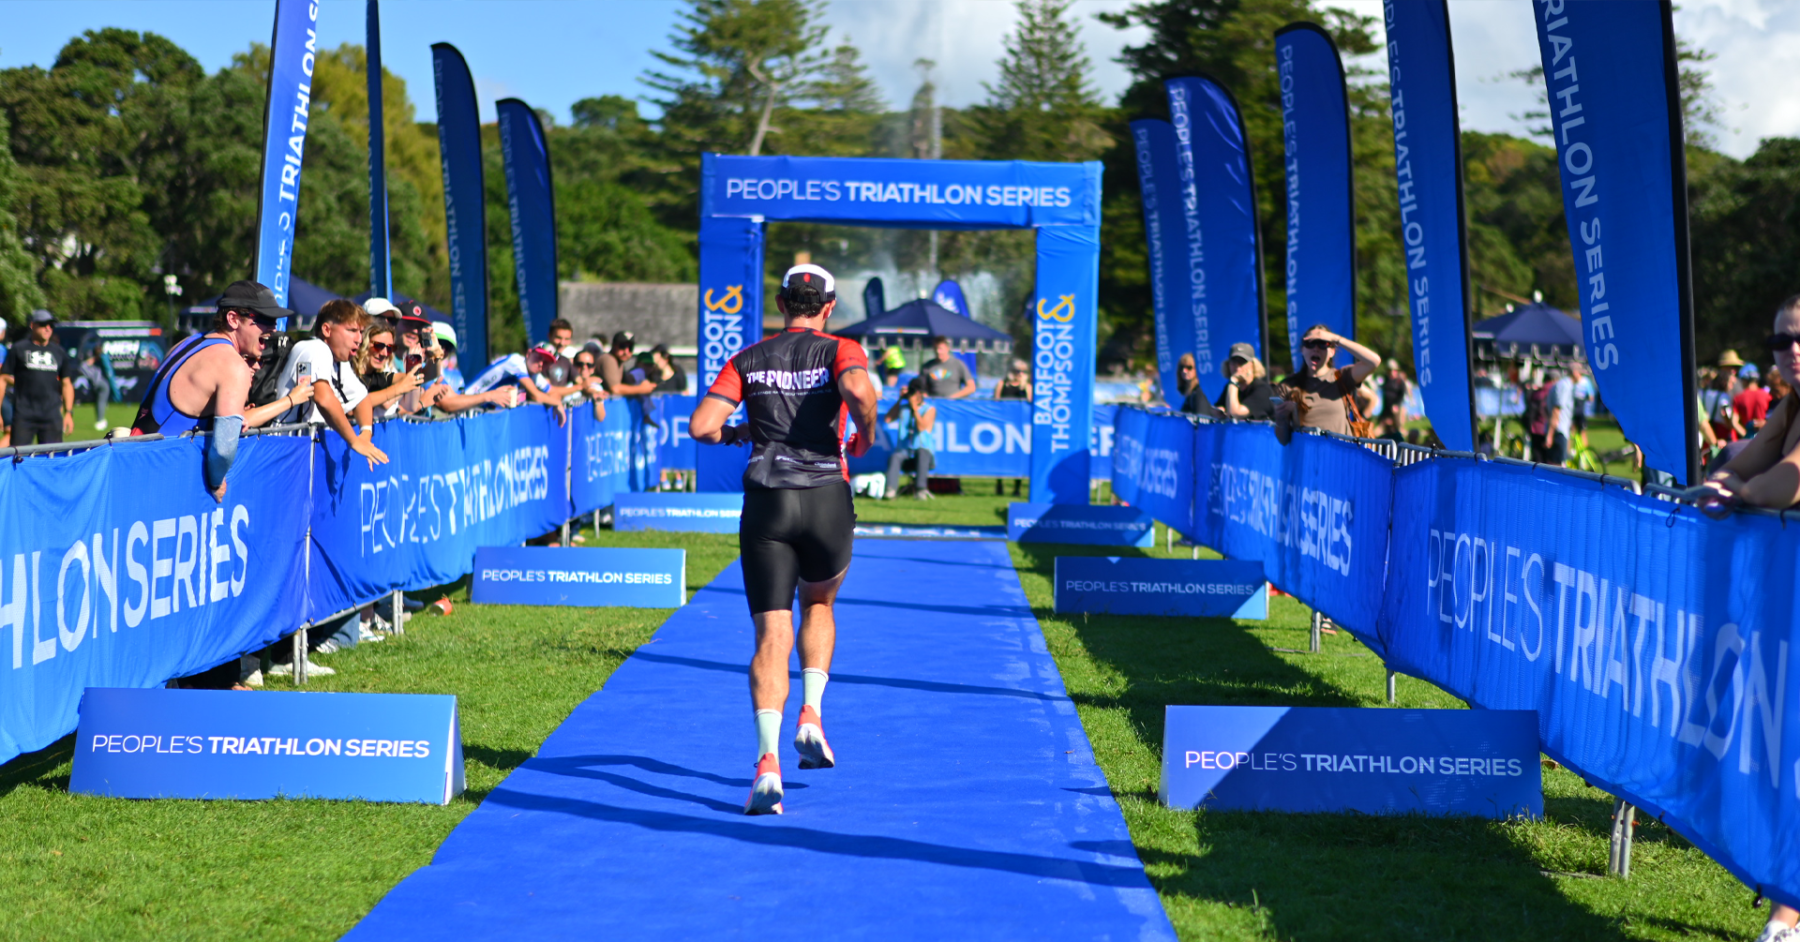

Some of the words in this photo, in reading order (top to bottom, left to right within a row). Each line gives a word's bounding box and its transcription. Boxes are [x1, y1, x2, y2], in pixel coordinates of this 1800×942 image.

[726, 178, 841, 201] PEOPLE'S
[845, 181, 983, 205] TRIATHLON
[986, 185, 1071, 208] SERIES
[1284, 157, 1301, 300] TRIATHLON
[1148, 210, 1166, 308] TRIATHLON
[1181, 183, 1207, 300] TRIATHLON
[1390, 89, 1428, 270] TRIATHLON
[1413, 275, 1433, 388] SERIES
[454, 280, 469, 355] SERIES
[1579, 216, 1619, 371] SERIES
[1155, 309, 1172, 375] SERIES
[1191, 302, 1212, 375] SERIES
[746, 371, 765, 384] THE
[766, 367, 829, 390] PIONEER
[1033, 319, 1055, 425] BARFOOT
[1051, 324, 1074, 454] THOMPSON
[666, 508, 718, 518] TRIATHLON
[1060, 520, 1111, 530] TRIATHLON
[1300, 486, 1353, 577] SERIES
[124, 504, 249, 628] SERIES
[482, 568, 546, 583] PEOPLE'S
[548, 570, 623, 585] TRIATHLON
[625, 572, 672, 586] SERIES
[1066, 579, 1129, 593] PEOPLE'S
[1130, 581, 1205, 594] TRIATHLON
[1207, 583, 1254, 596] SERIES
[1427, 528, 1545, 662] PEOPLE'S
[1553, 561, 1788, 790] TRIATHLON
[92, 735, 203, 754] PEOPLE'S
[207, 736, 341, 757] TRIATHLON
[345, 738, 430, 759] SERIES
[1185, 750, 1296, 771] PEOPLE'S
[1301, 753, 1434, 775] TRIATHLON
[1439, 756, 1523, 777] SERIES
